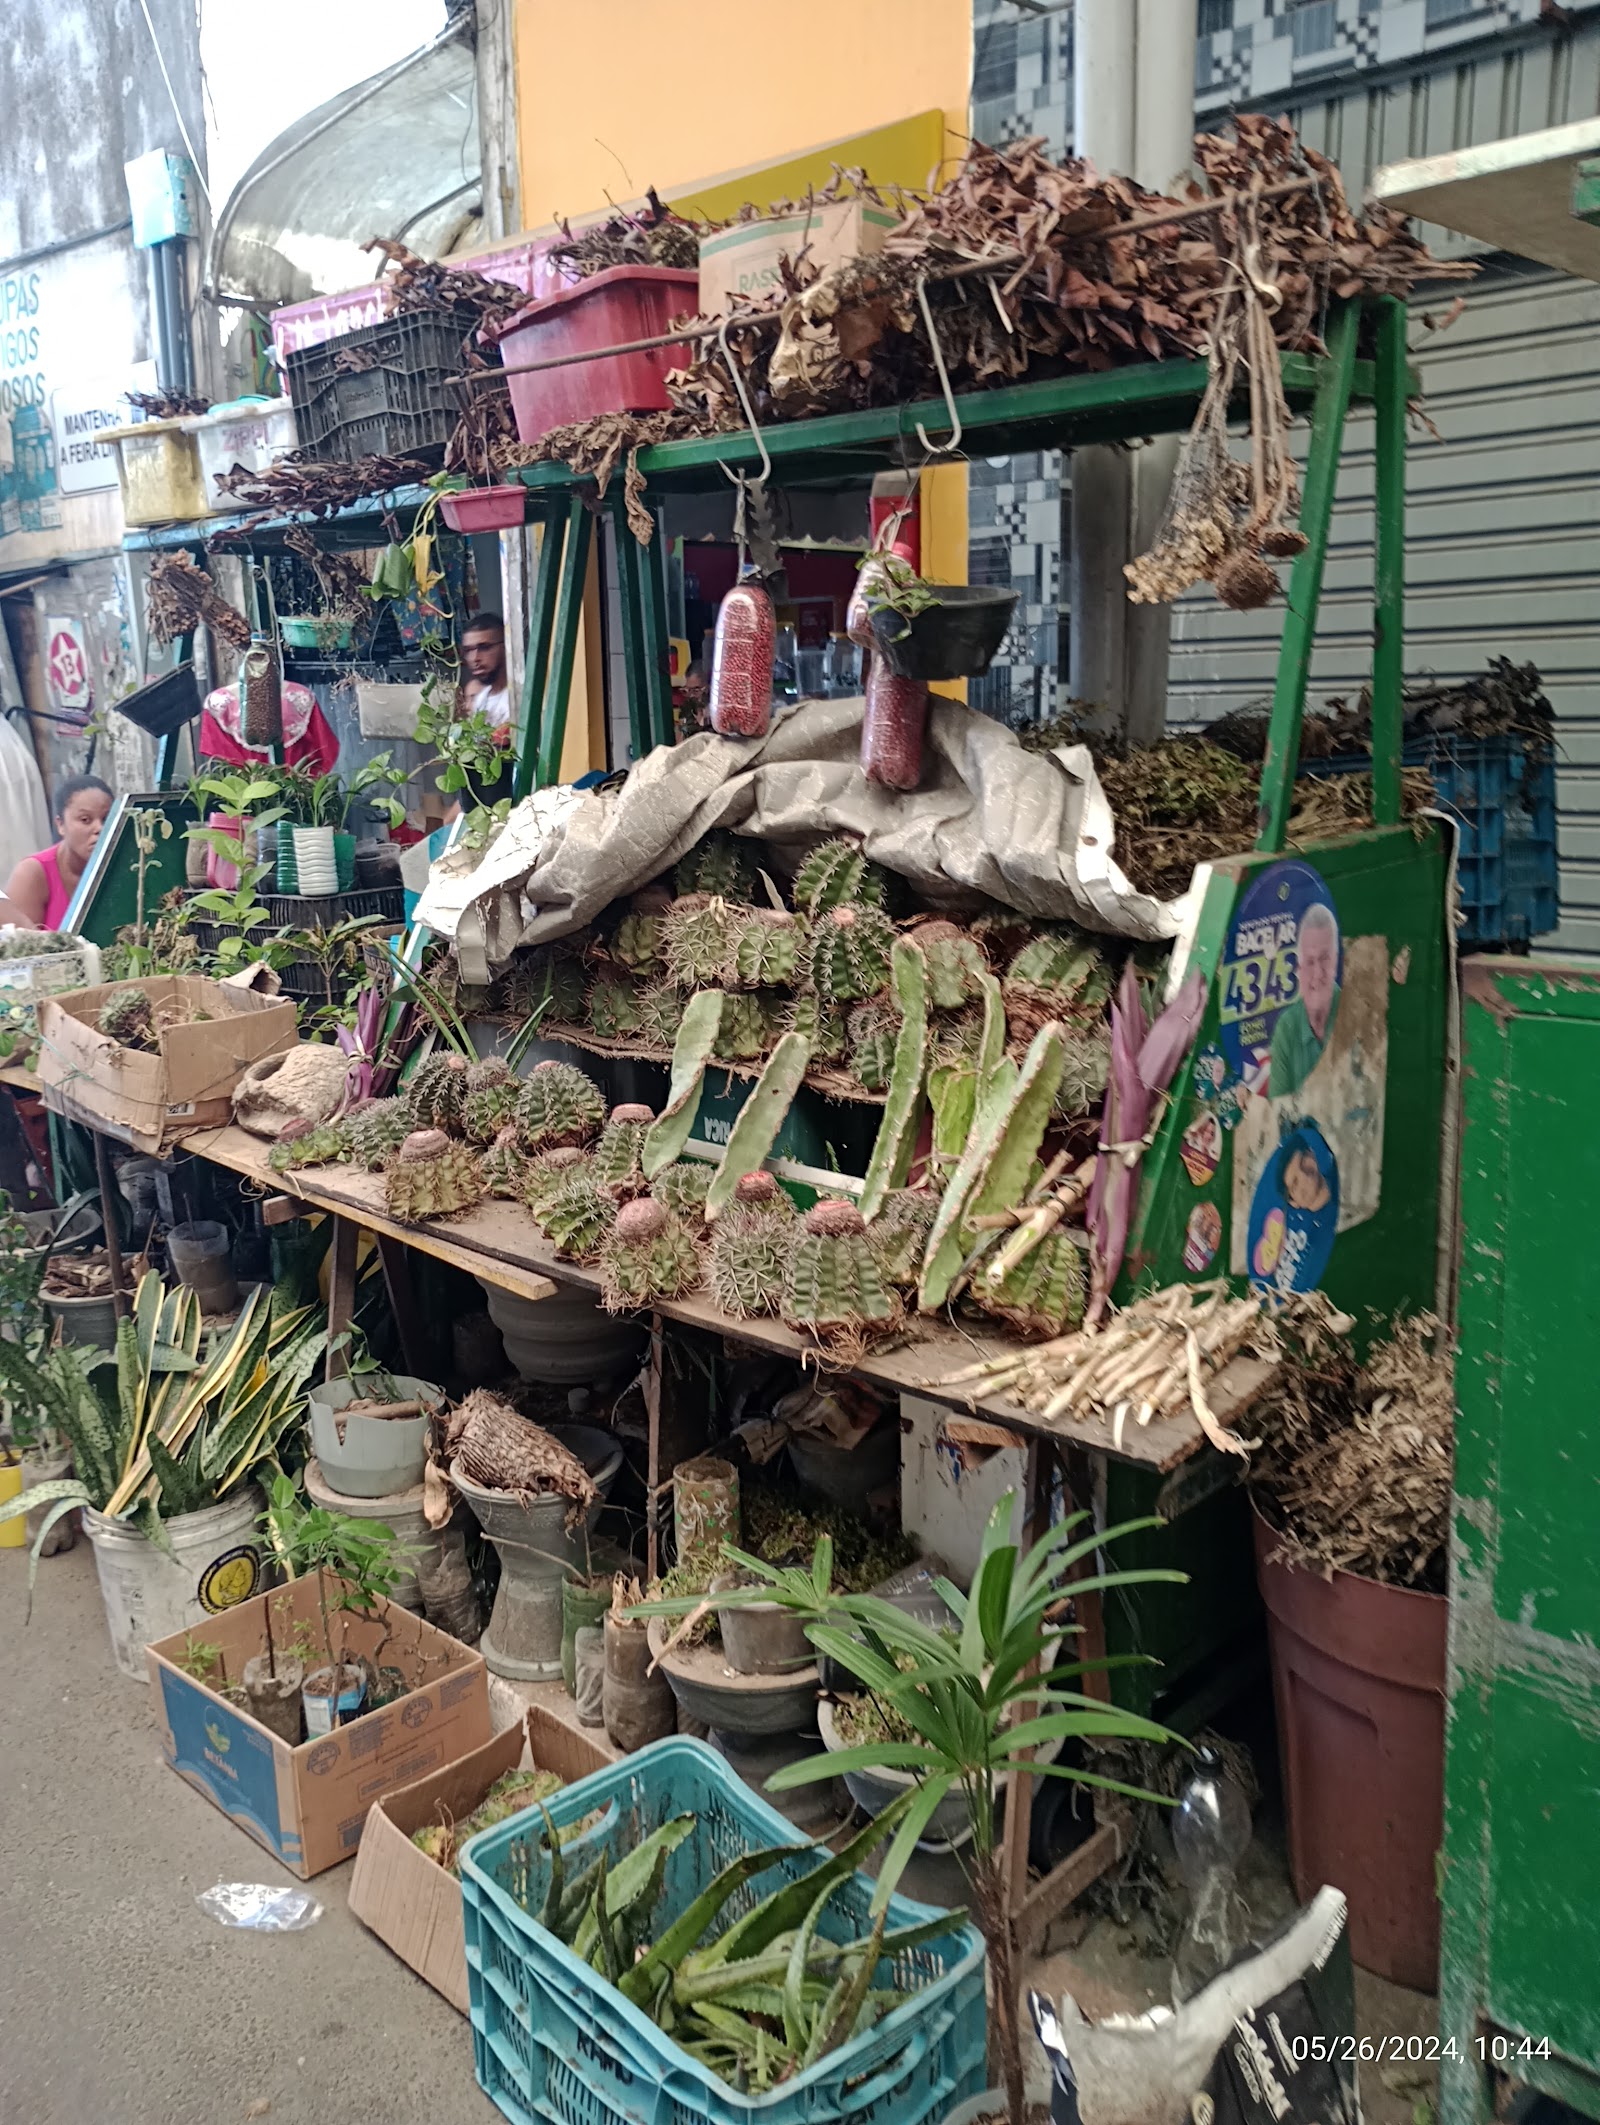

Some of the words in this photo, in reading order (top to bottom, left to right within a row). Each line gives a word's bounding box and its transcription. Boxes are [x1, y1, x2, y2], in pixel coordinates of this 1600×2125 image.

[60, 446, 69, 466] A
[69, 441, 100, 464] FEIRA
[61, 654, 75, 676] 13
[1236, 920, 1297, 957] BACEAR
[1223, 951, 1301, 1017] 4343
